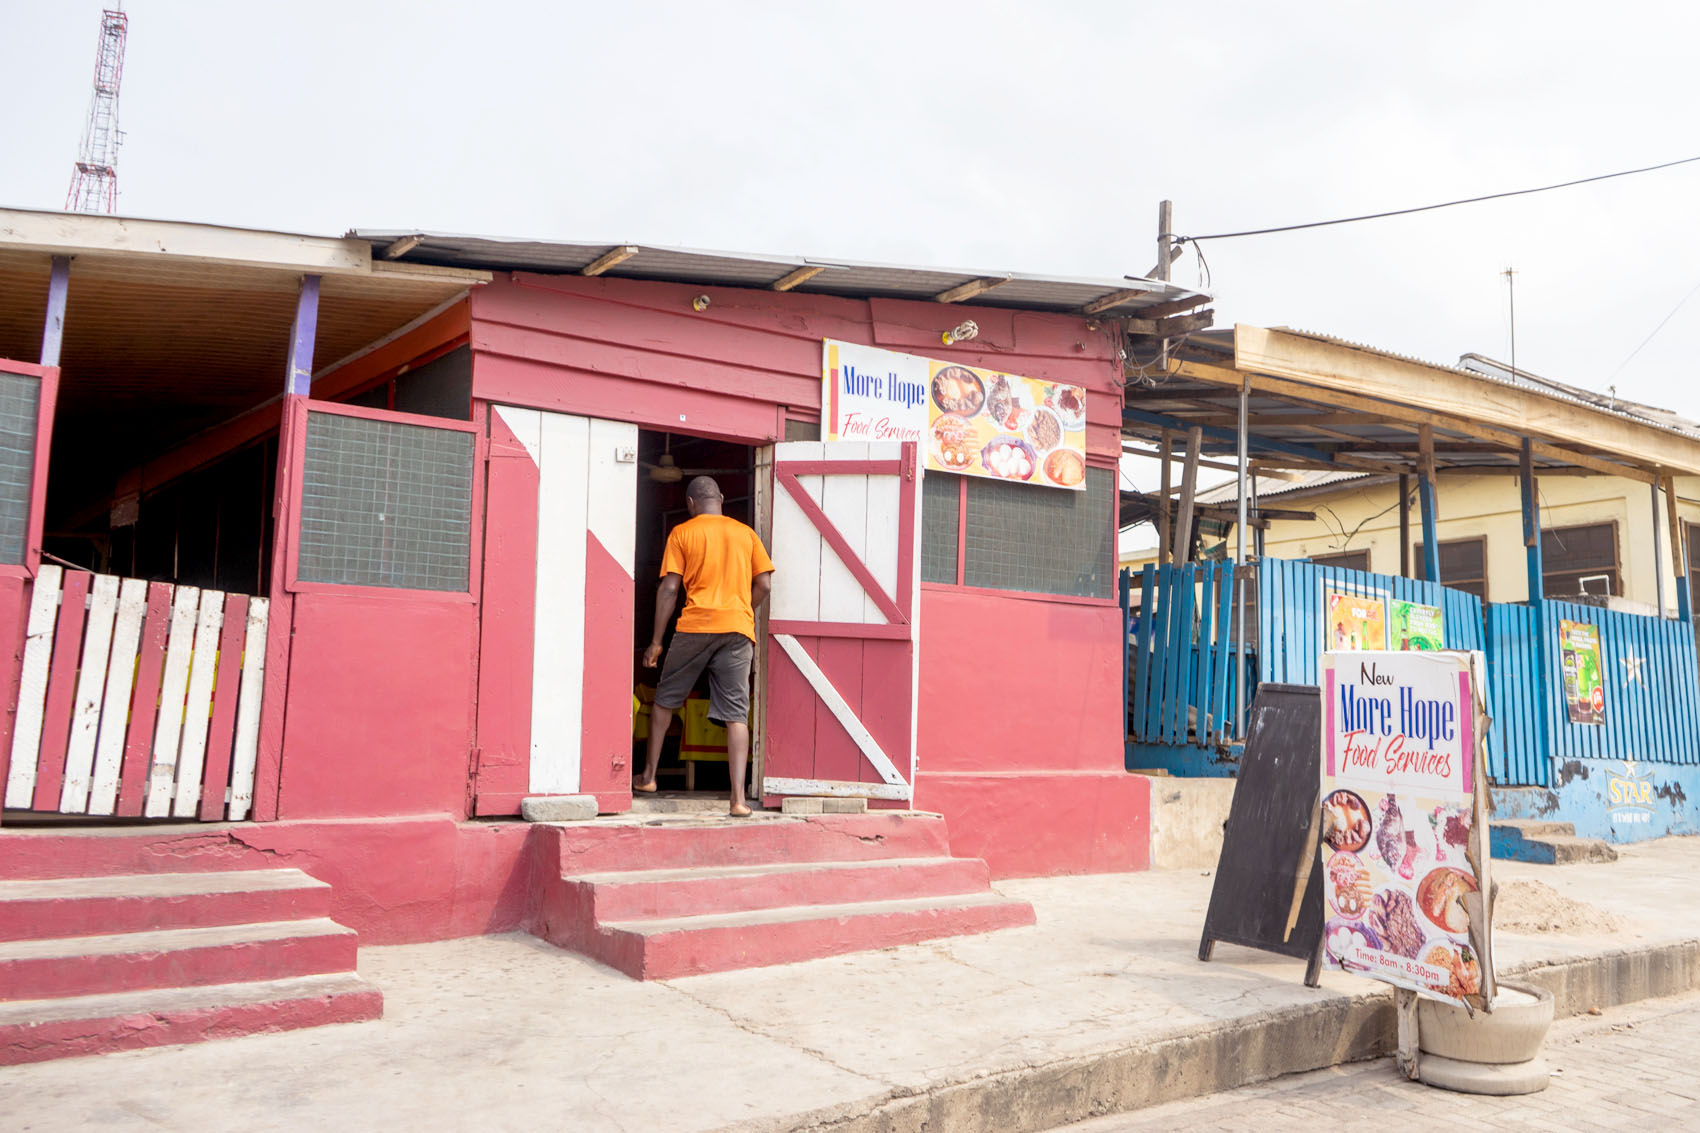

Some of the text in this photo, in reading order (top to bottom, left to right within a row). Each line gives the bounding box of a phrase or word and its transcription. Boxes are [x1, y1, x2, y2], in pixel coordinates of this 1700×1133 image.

[843, 364, 925, 409] More Hope
[842, 412, 920, 441] Food Services
[1361, 661, 1394, 686] New
[1340, 684, 1454, 749] More Hope
[1342, 729, 1451, 778] Food Services
[1611, 777, 1652, 804] STAR
[1355, 948, 1377, 963] Time:
[1379, 955, 1398, 969] 8am
[1406, 962, 1440, 982] 8:30pm
